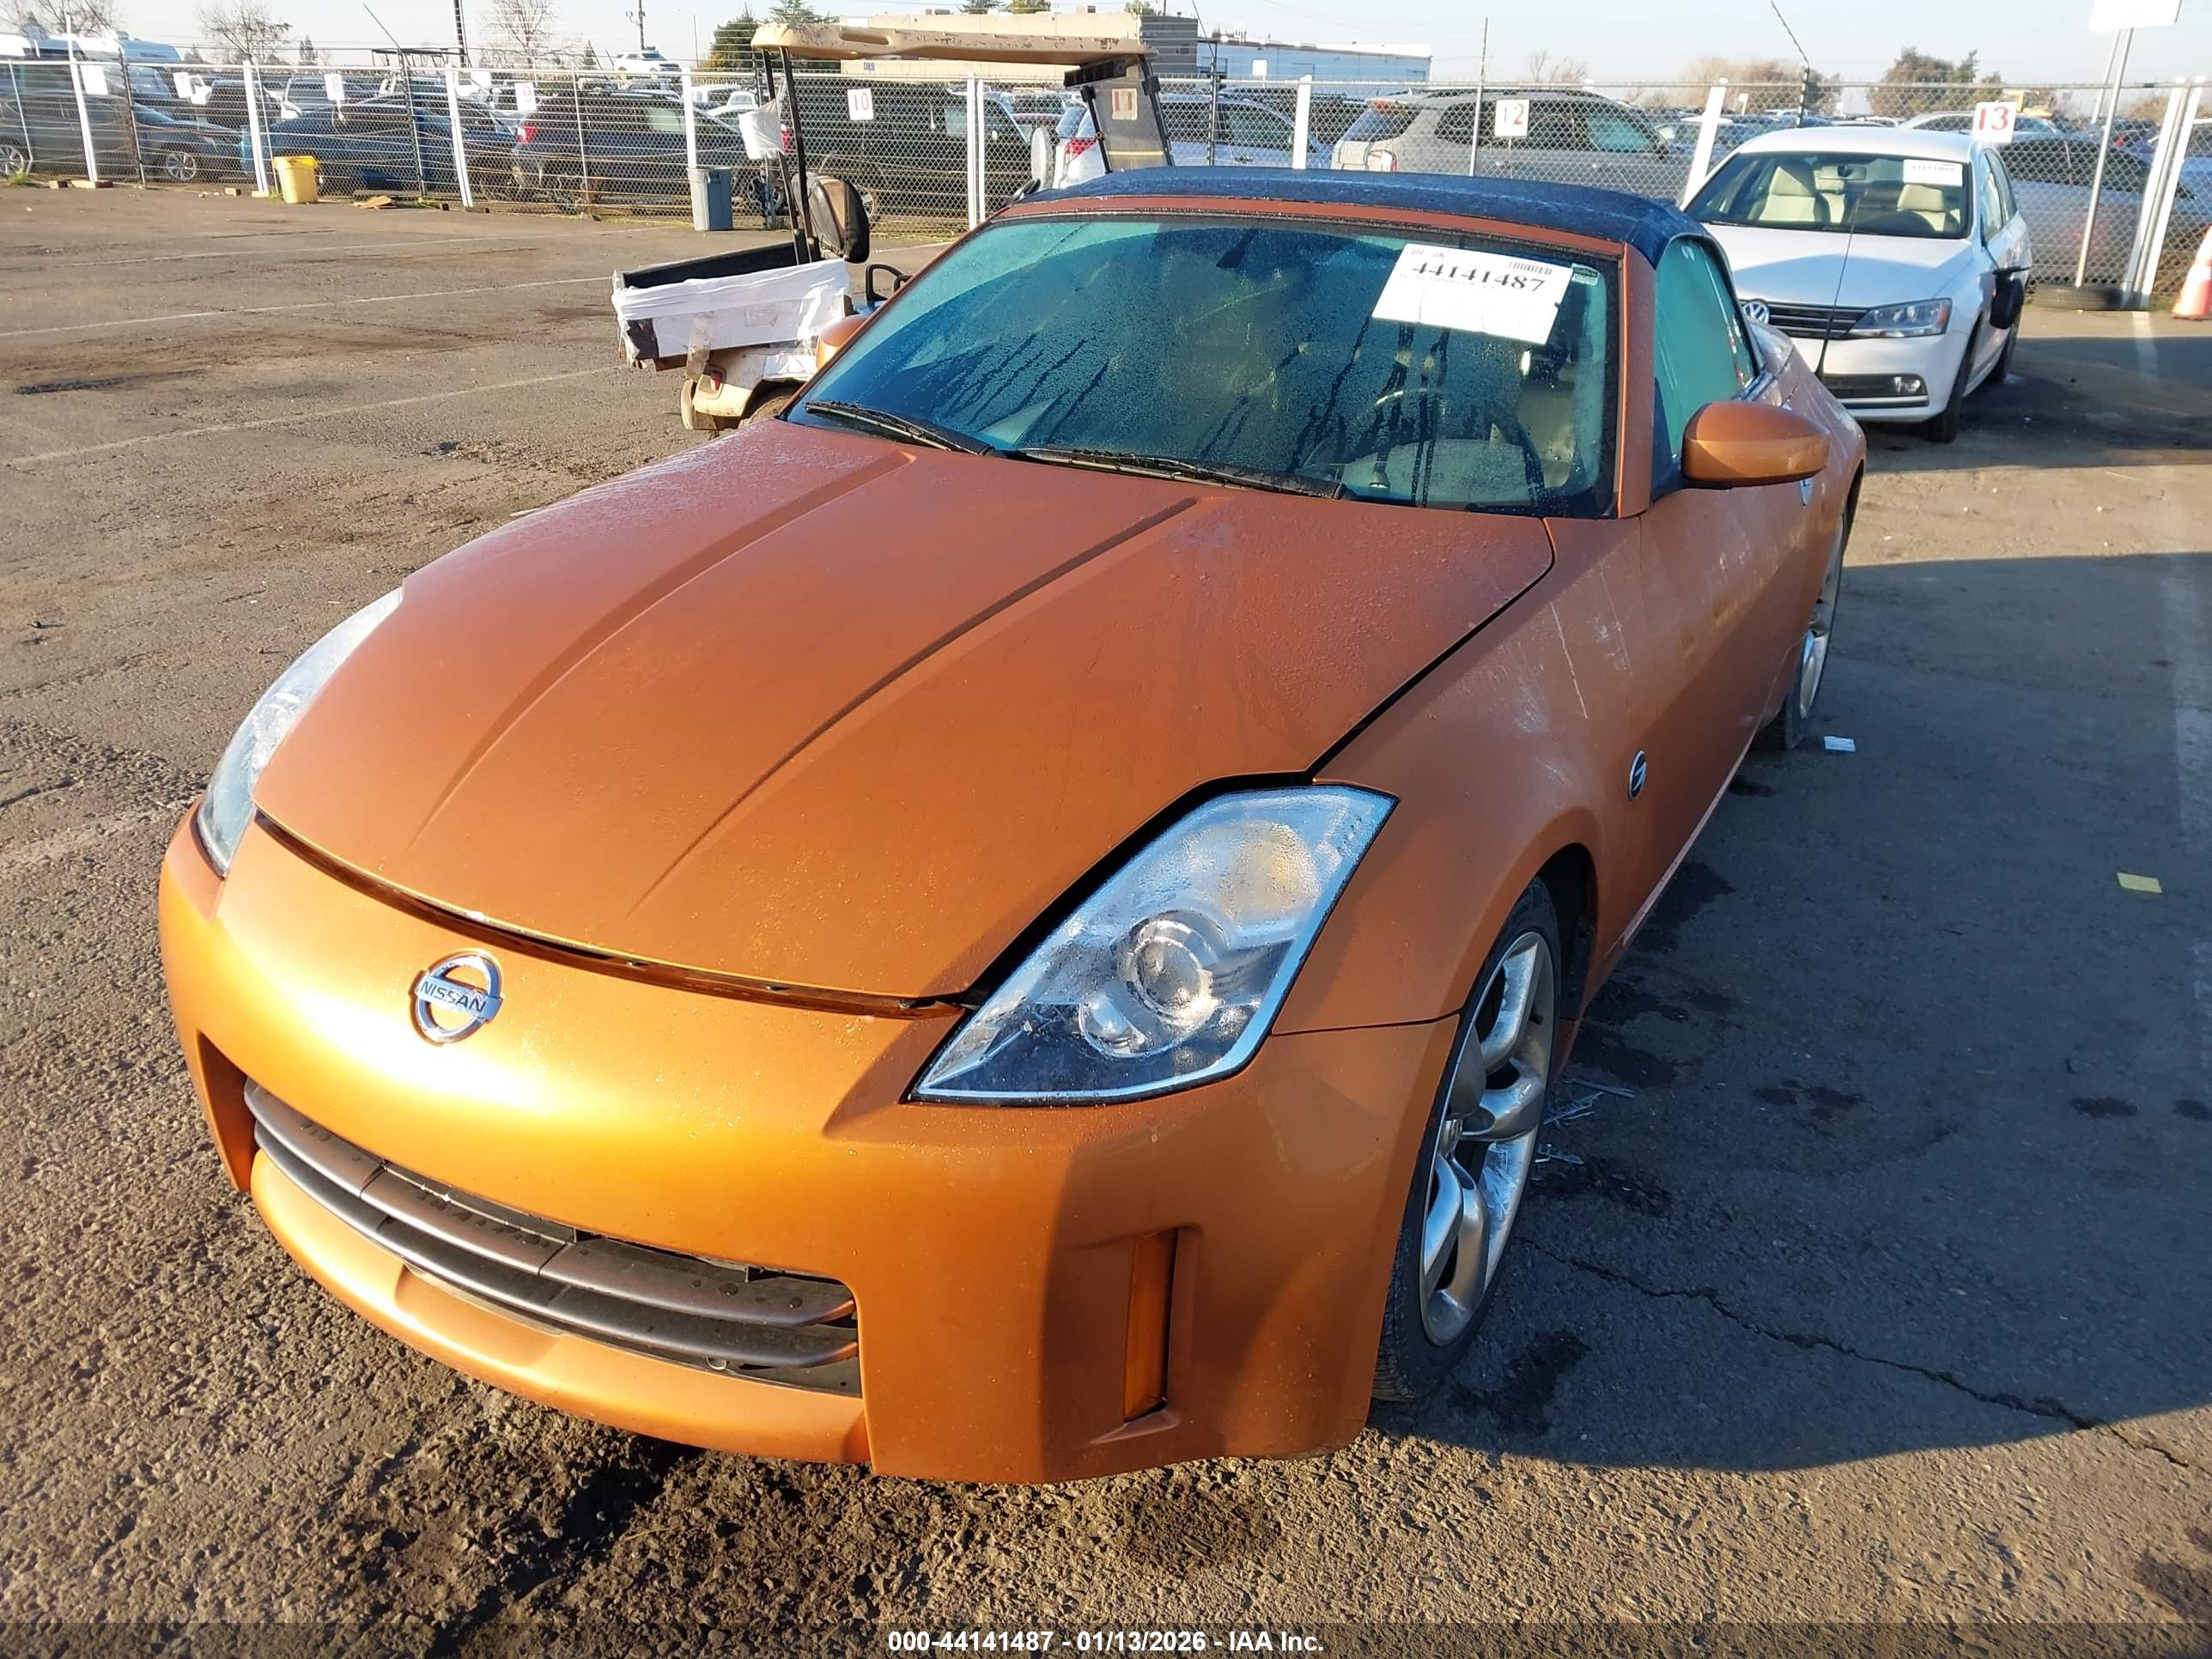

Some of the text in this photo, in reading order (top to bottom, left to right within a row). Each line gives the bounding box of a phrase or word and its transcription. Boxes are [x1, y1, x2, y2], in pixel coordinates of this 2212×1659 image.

[331, 76, 341, 92] 8
[854, 92, 869, 111] 10
[1114, 91, 1133, 111] 11
[1504, 103, 1525, 125] 12
[1978, 106, 2009, 131] 13
[1411, 260, 1547, 292] 44141487
[420, 980, 487, 1013] NISSAN
